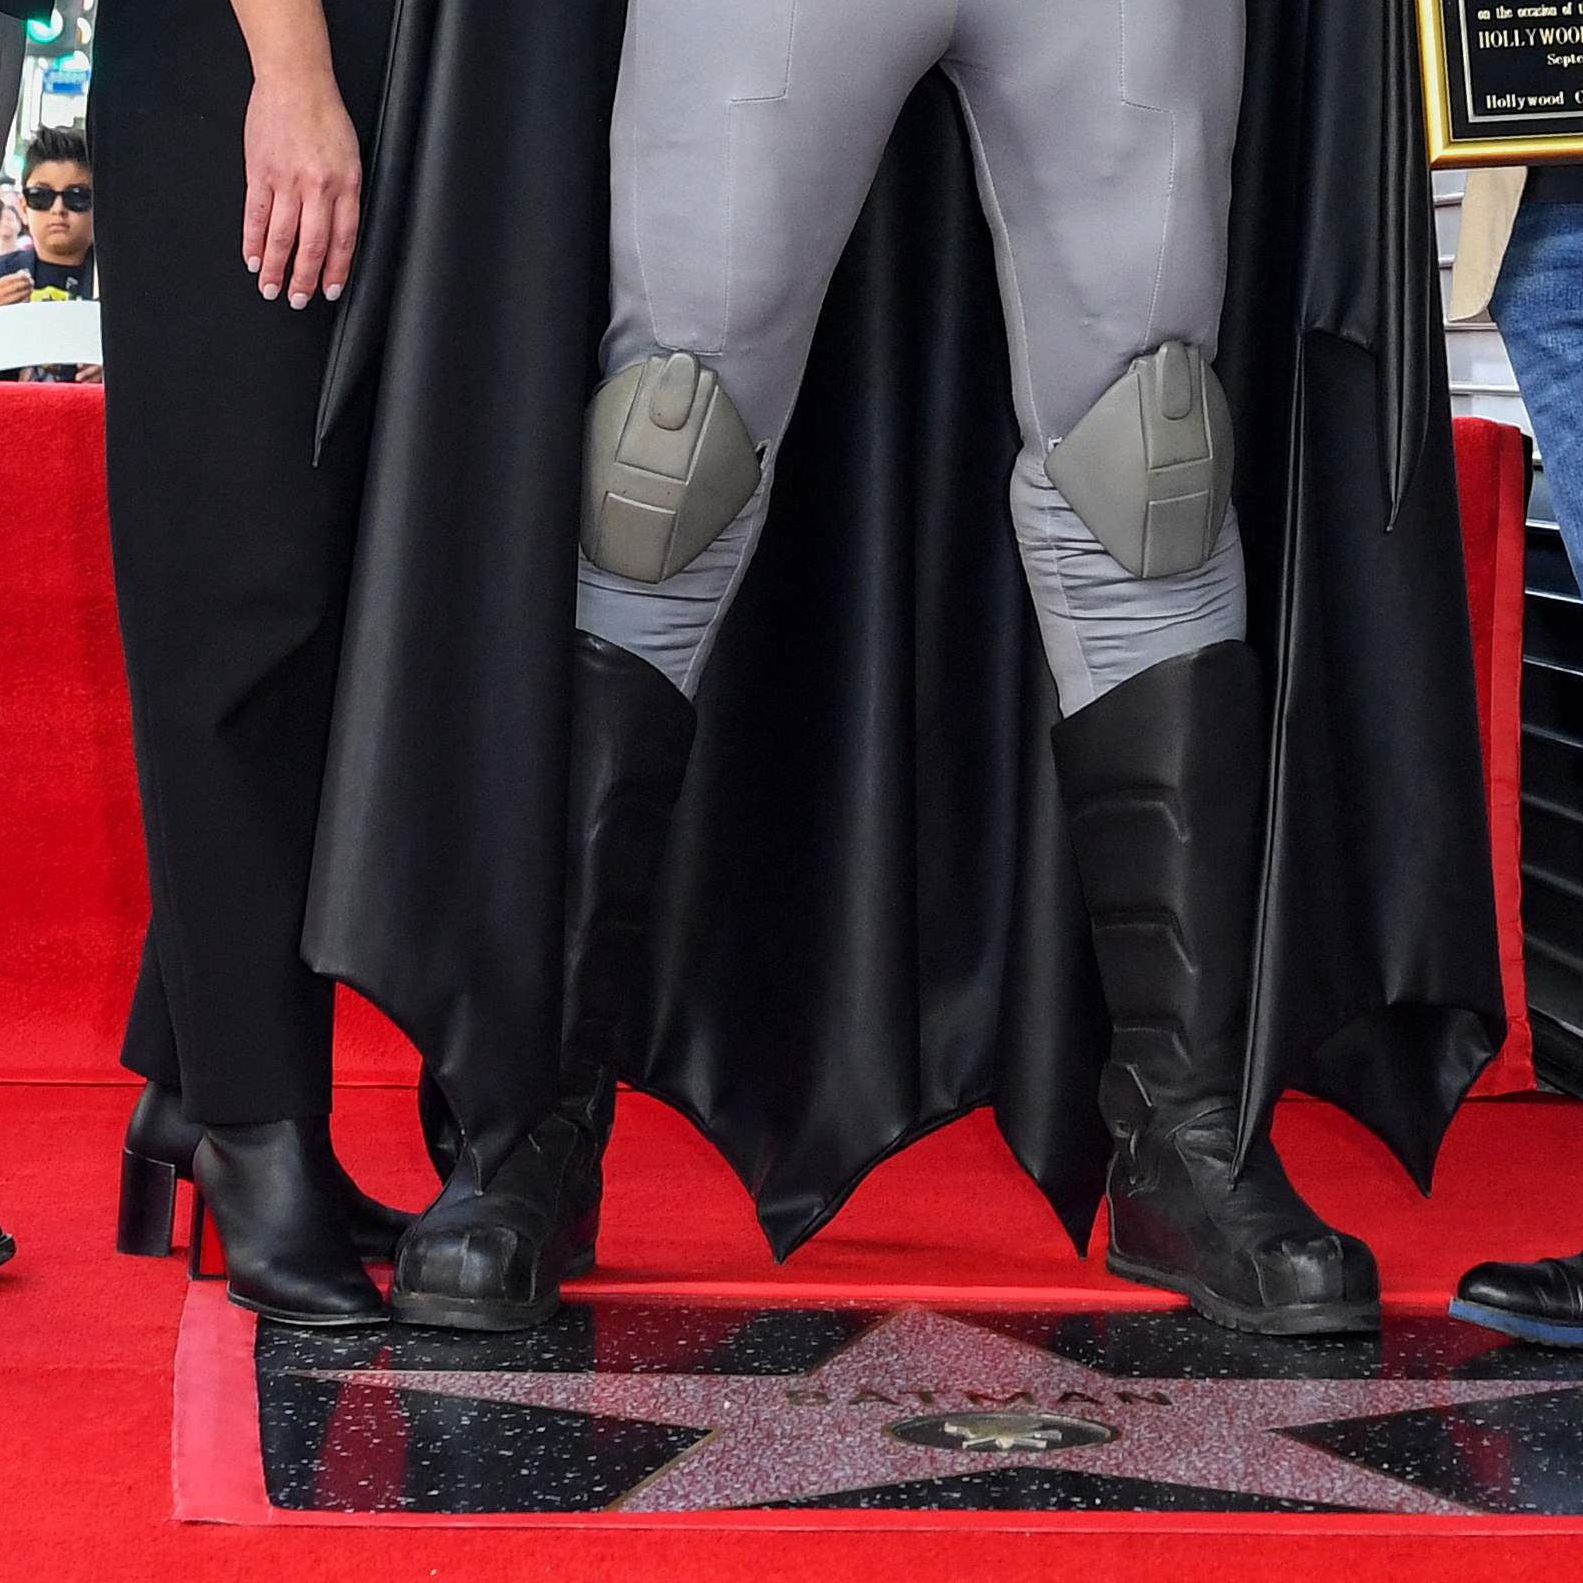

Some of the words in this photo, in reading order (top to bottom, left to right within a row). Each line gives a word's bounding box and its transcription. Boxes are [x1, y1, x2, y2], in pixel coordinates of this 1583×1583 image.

[1478, 9, 1491, 20] on
[1495, 6, 1513, 19] the
[1517, 5, 1558, 18] occasion
[1562, 2, 1572, 16] of
[1486, 90, 1565, 110] Hollywood
